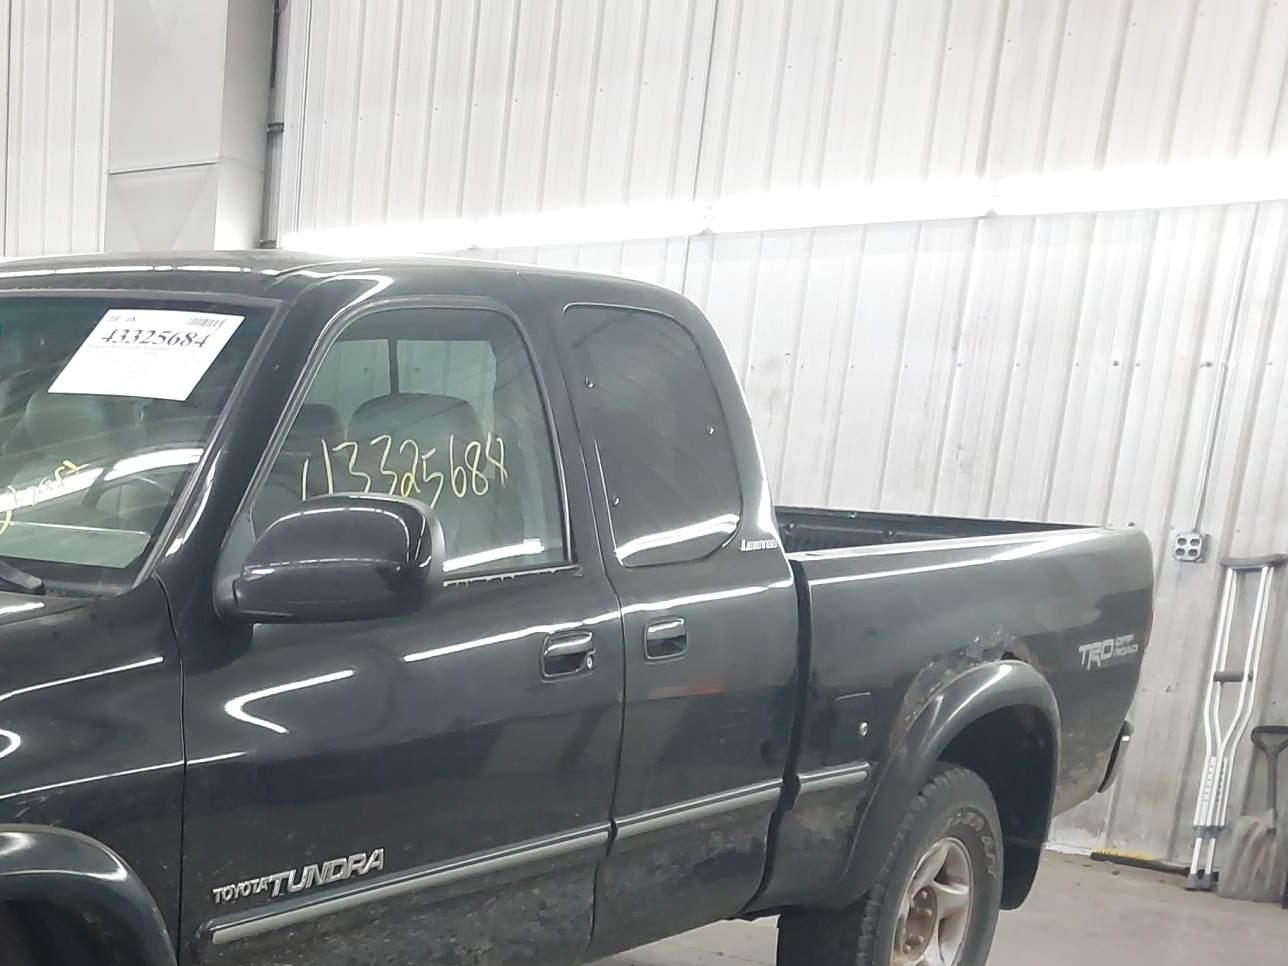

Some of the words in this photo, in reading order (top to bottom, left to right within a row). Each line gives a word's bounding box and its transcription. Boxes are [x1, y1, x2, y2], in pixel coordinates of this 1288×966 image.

[101, 328, 211, 348] 43325684
[1079, 638, 1114, 671] TRD
[212, 875, 271, 904] TOYOTA
[268, 848, 385, 897] TUNDRA
